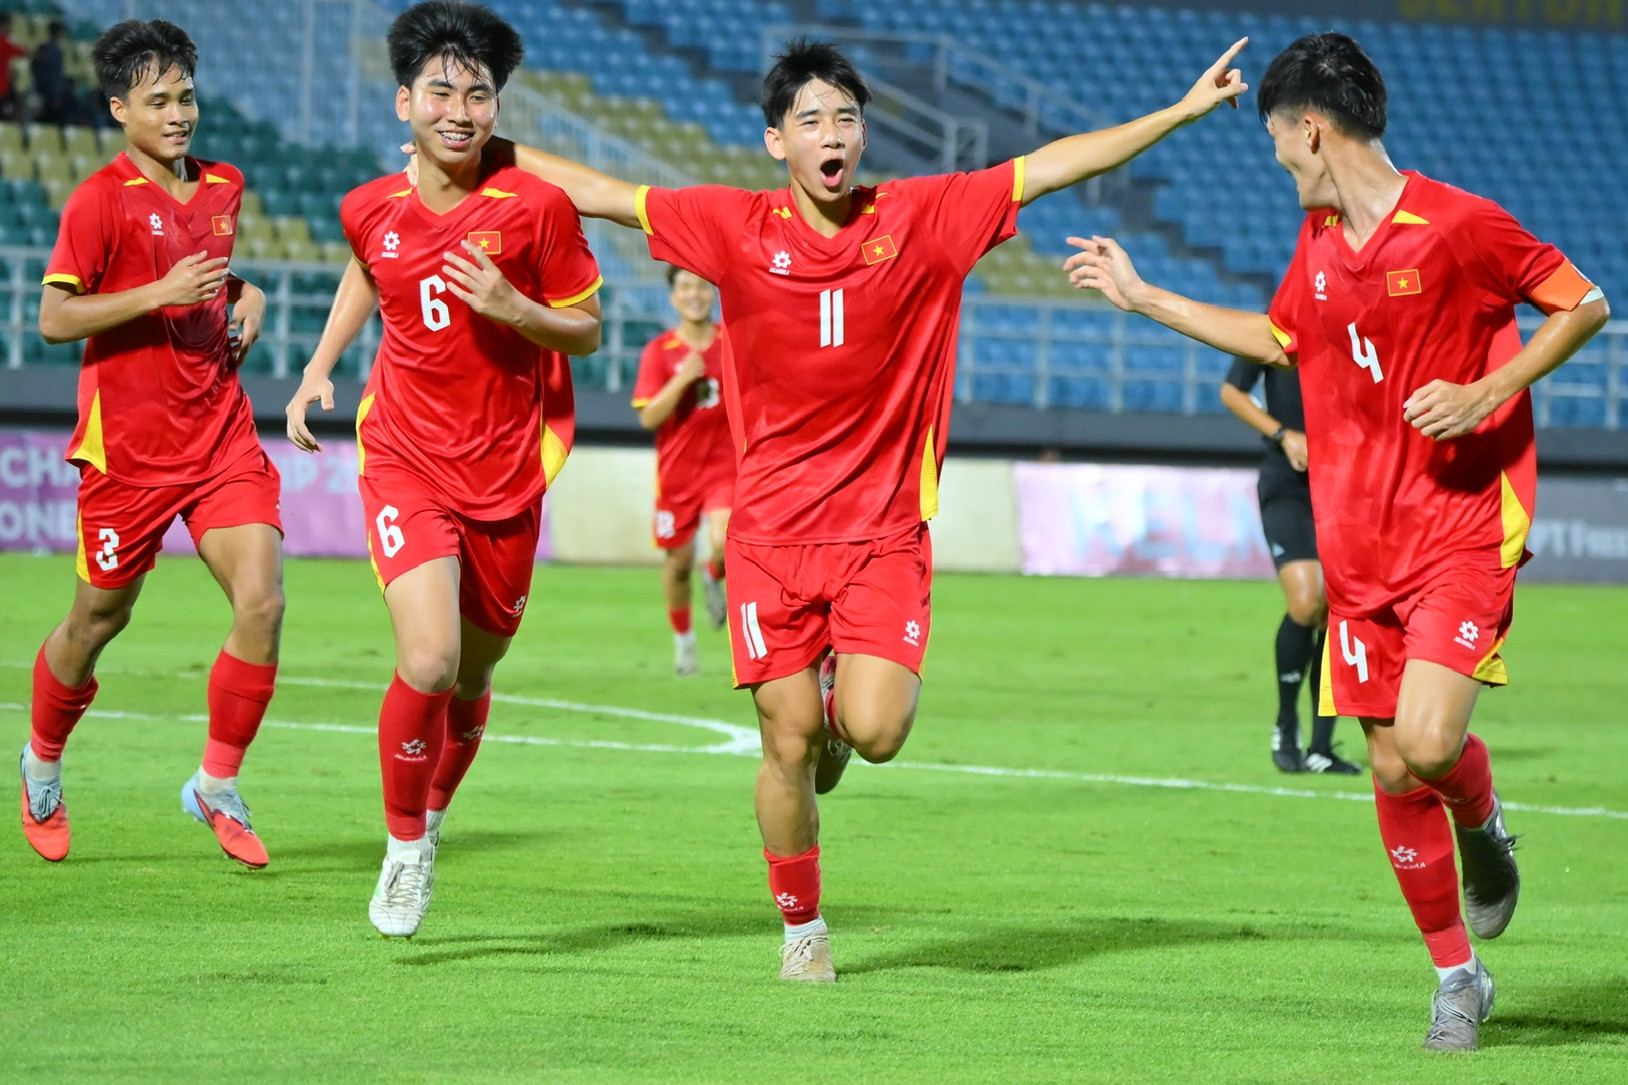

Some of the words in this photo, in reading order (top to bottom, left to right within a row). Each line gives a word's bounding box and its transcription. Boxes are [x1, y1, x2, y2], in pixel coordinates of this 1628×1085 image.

[419, 273, 451, 332] 6
[819, 288, 844, 348] 11
[1347, 321, 1384, 384] 4
[96, 528, 119, 571] 3
[376, 504, 405, 558] 6
[740, 601, 767, 660] 11
[1339, 619, 1369, 684] 4
